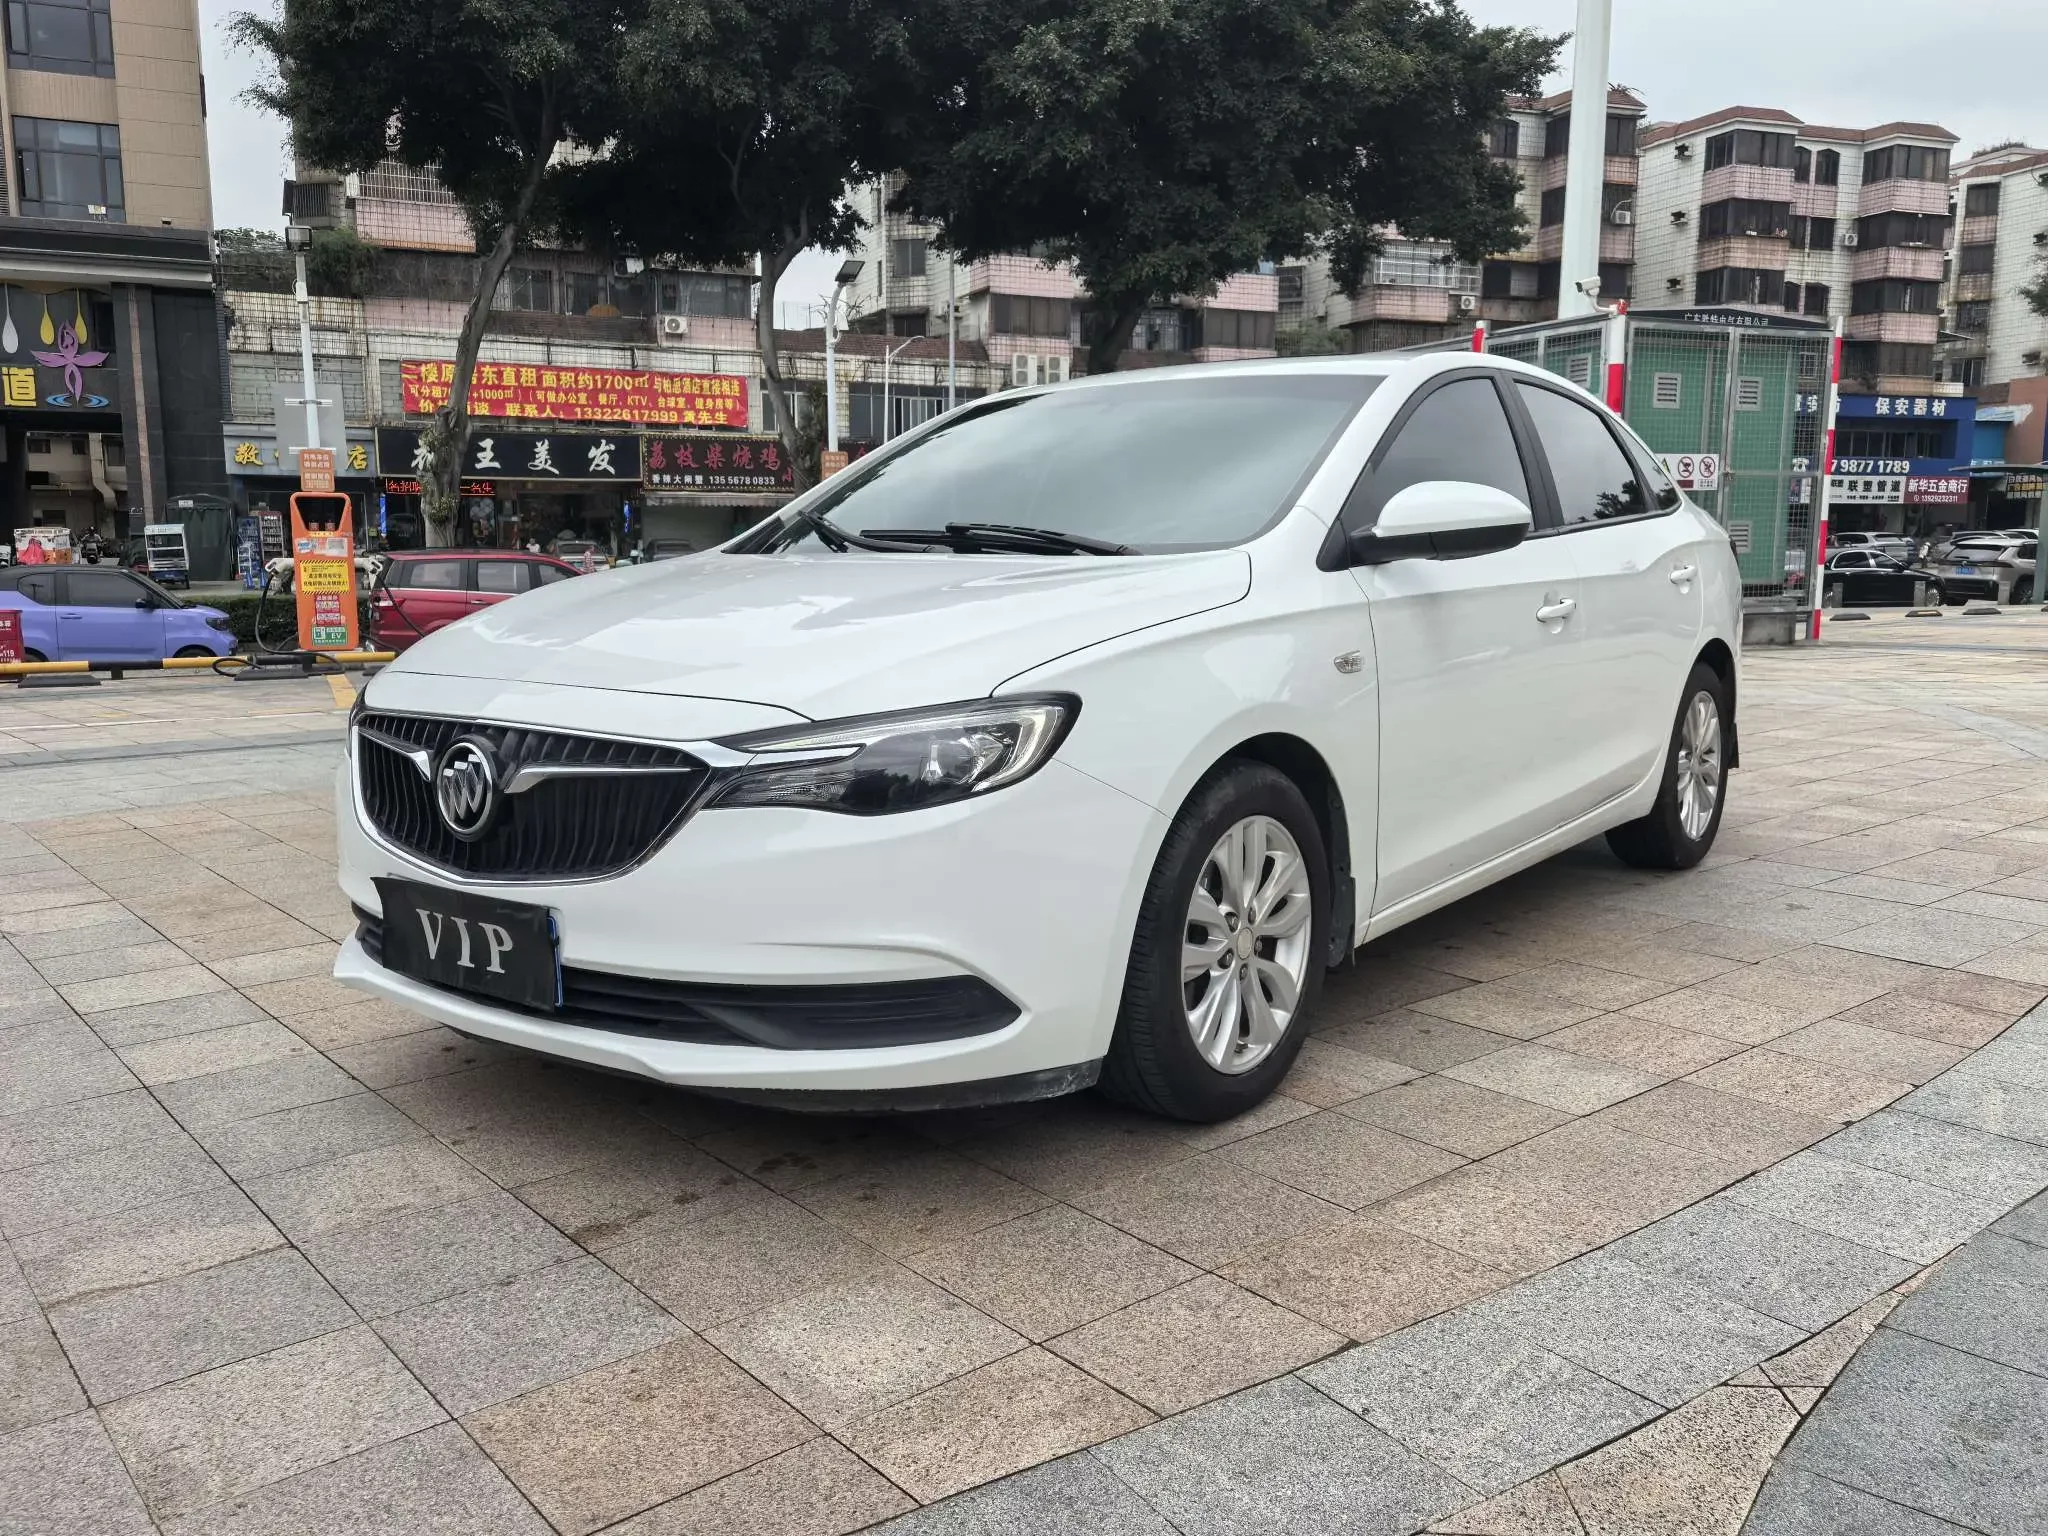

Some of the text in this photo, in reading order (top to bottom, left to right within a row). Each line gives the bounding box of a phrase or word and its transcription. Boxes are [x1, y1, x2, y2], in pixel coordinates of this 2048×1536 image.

[1, 367, 37, 407] 道
[418, 399, 490, 416] 价谈
[574, 407, 678, 422] 13322617999
[1875, 396, 1947, 417] 保安器材
[1840, 459, 1874, 473] 9877
[1878, 459, 1910, 473] 1789
[709, 475, 725, 484] 135
[728, 476, 750, 485] 5678
[752, 476, 775, 485] 0833
[1907, 478, 1968, 493] 新华五金商行
[415, 908, 514, 974] VIP
